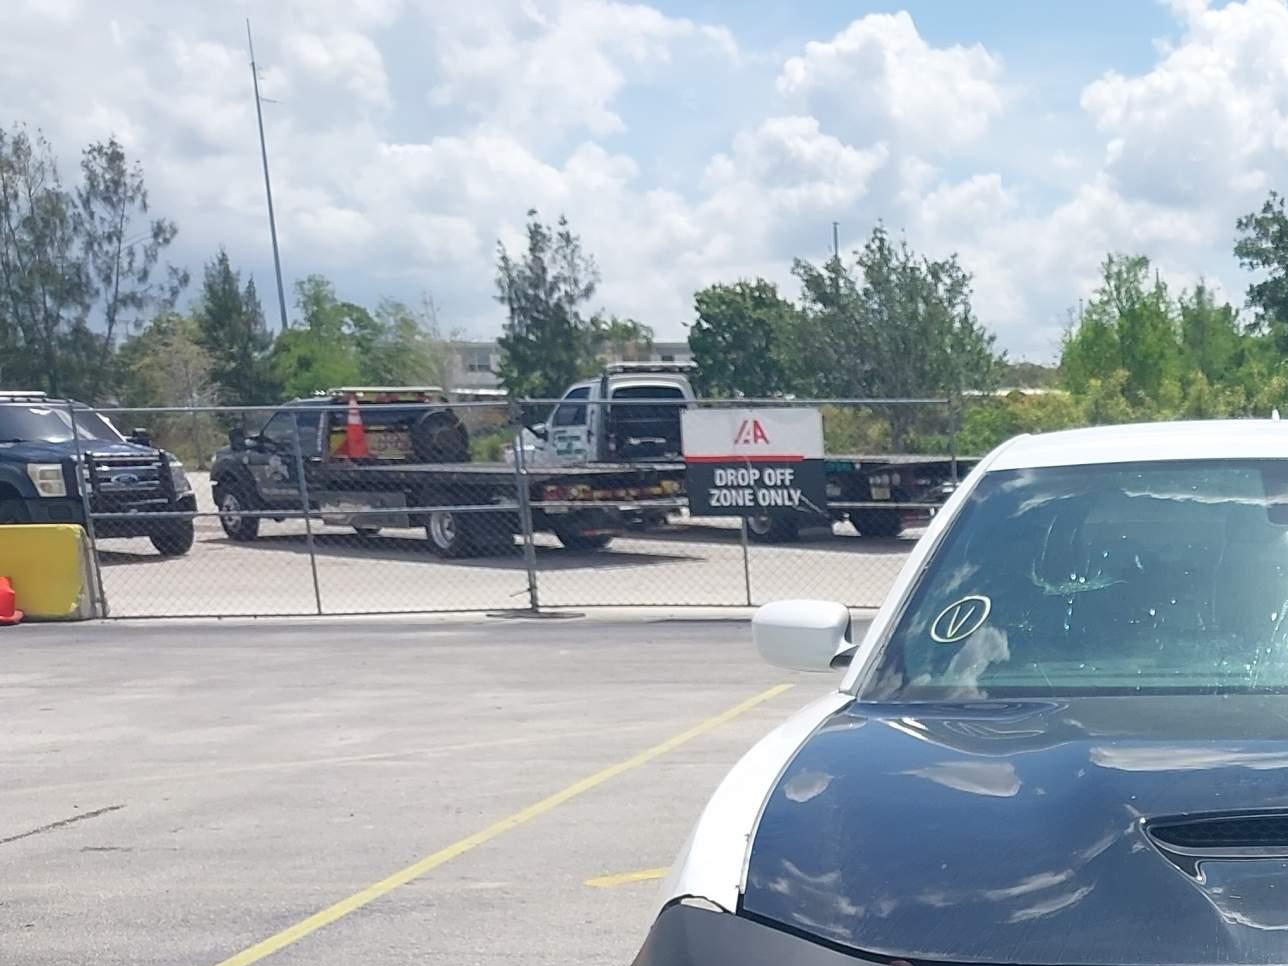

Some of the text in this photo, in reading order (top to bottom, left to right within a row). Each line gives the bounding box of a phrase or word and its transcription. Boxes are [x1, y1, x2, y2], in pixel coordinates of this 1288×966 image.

[713, 467, 795, 487] DROP OFF
[708, 488, 802, 507] ZONE ONLY
